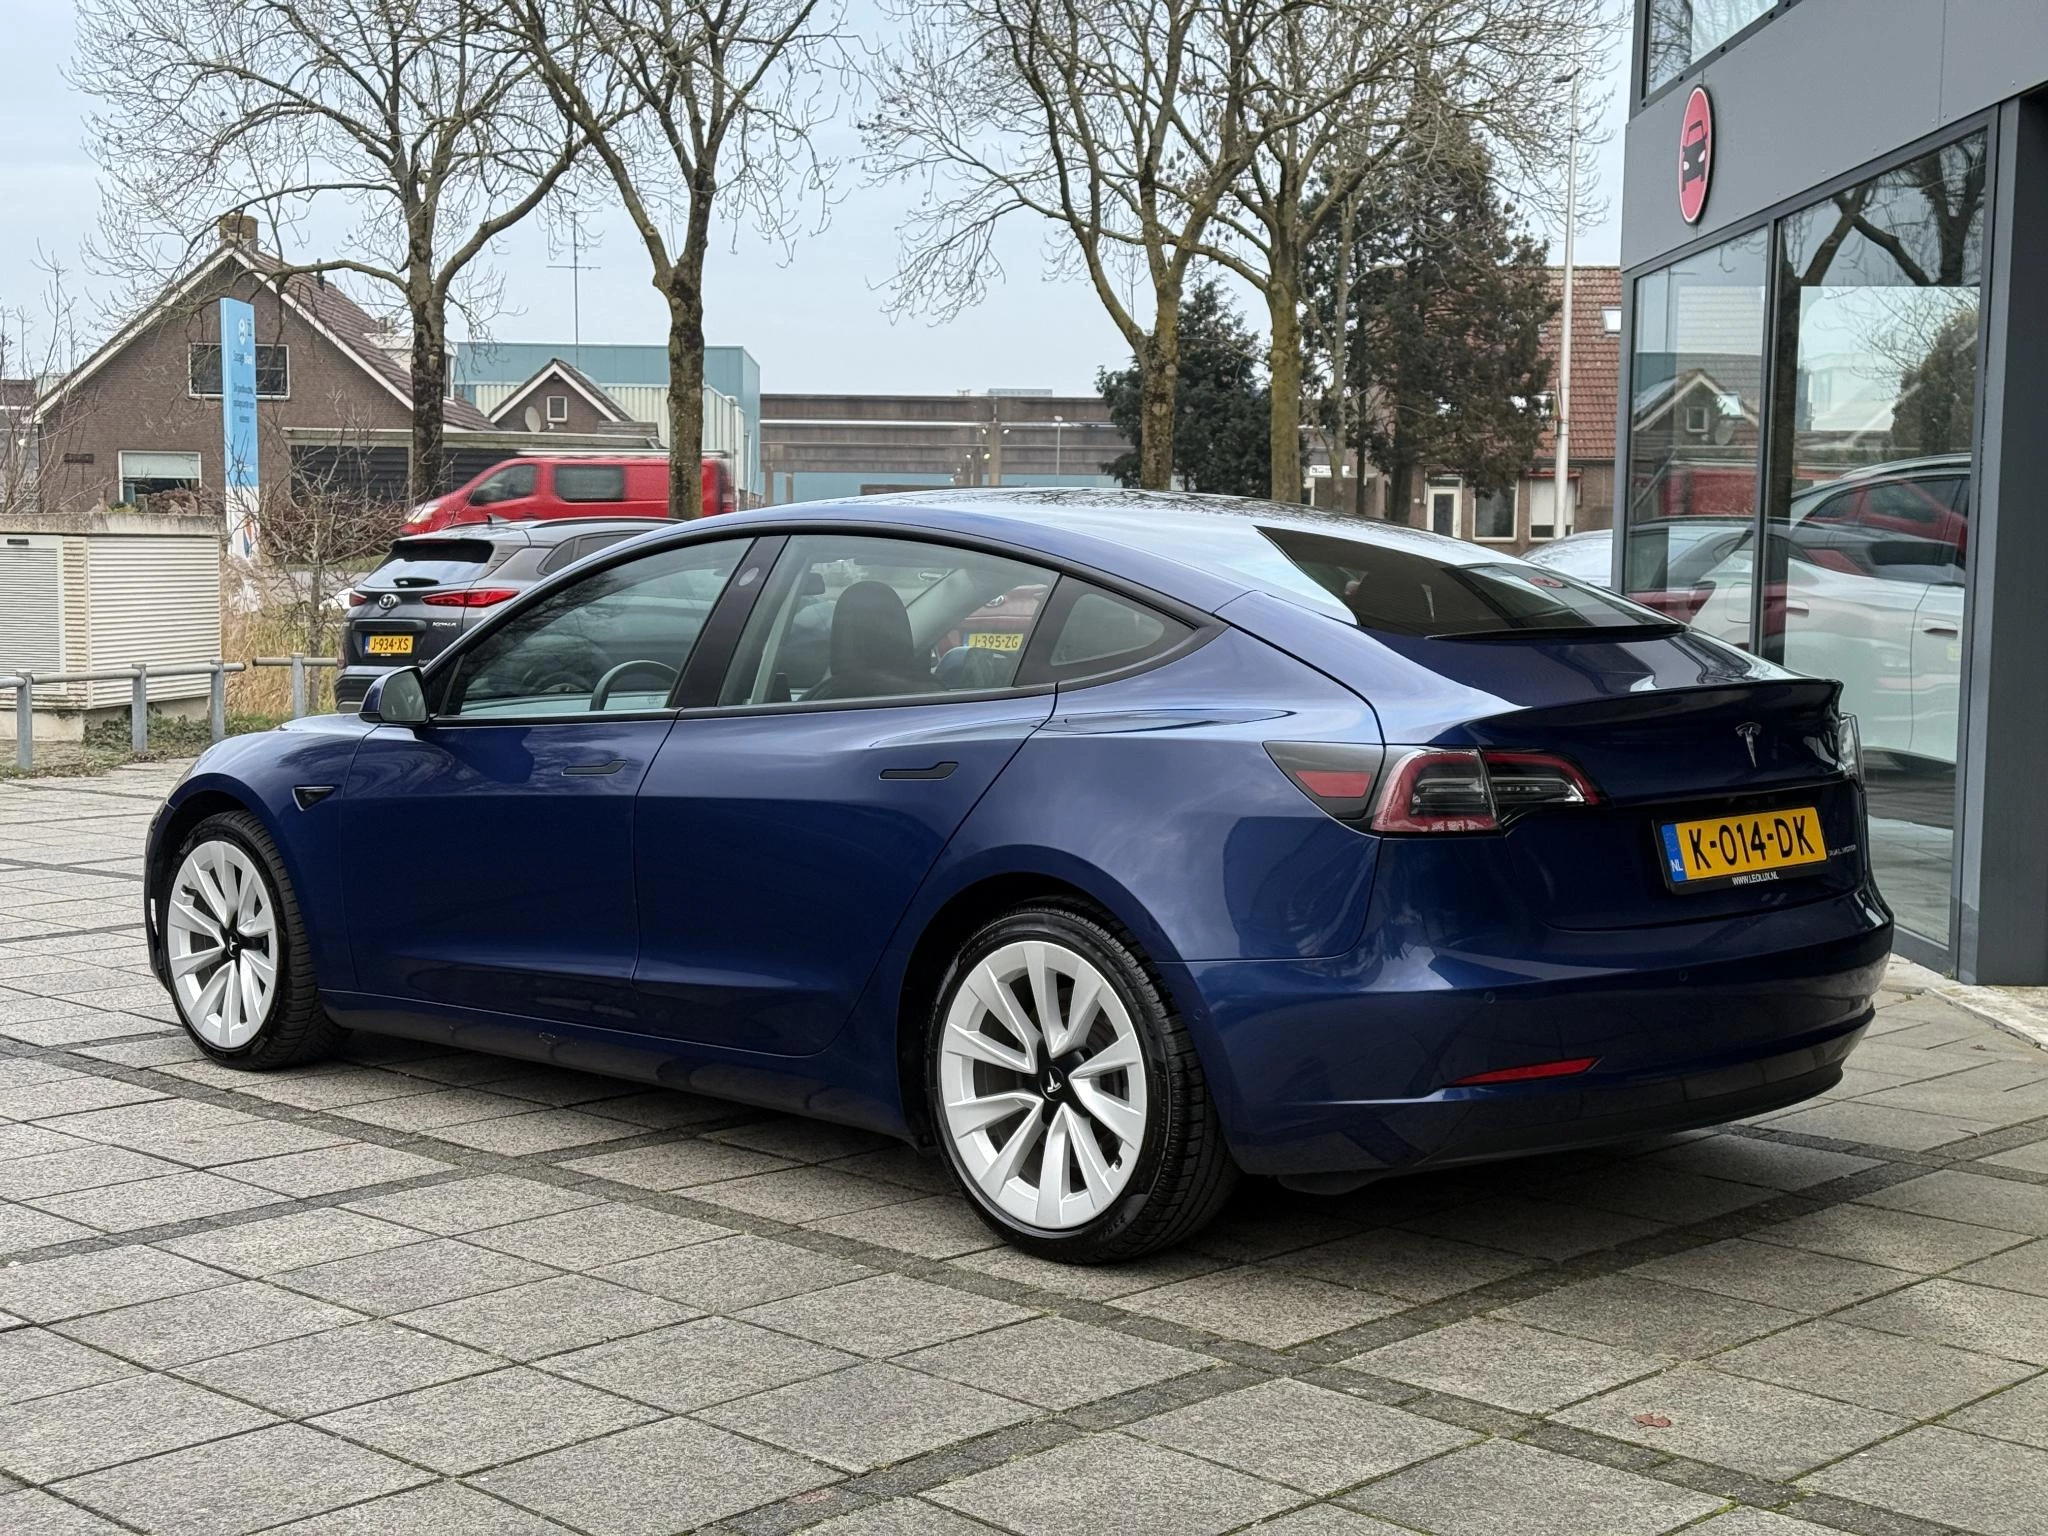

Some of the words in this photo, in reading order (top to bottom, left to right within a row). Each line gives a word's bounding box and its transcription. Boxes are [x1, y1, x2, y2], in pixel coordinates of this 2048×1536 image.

[371, 637, 409, 651] J-934-XS
[1688, 815, 1816, 871] K-014-DK
[1670, 858, 1684, 872] NL
